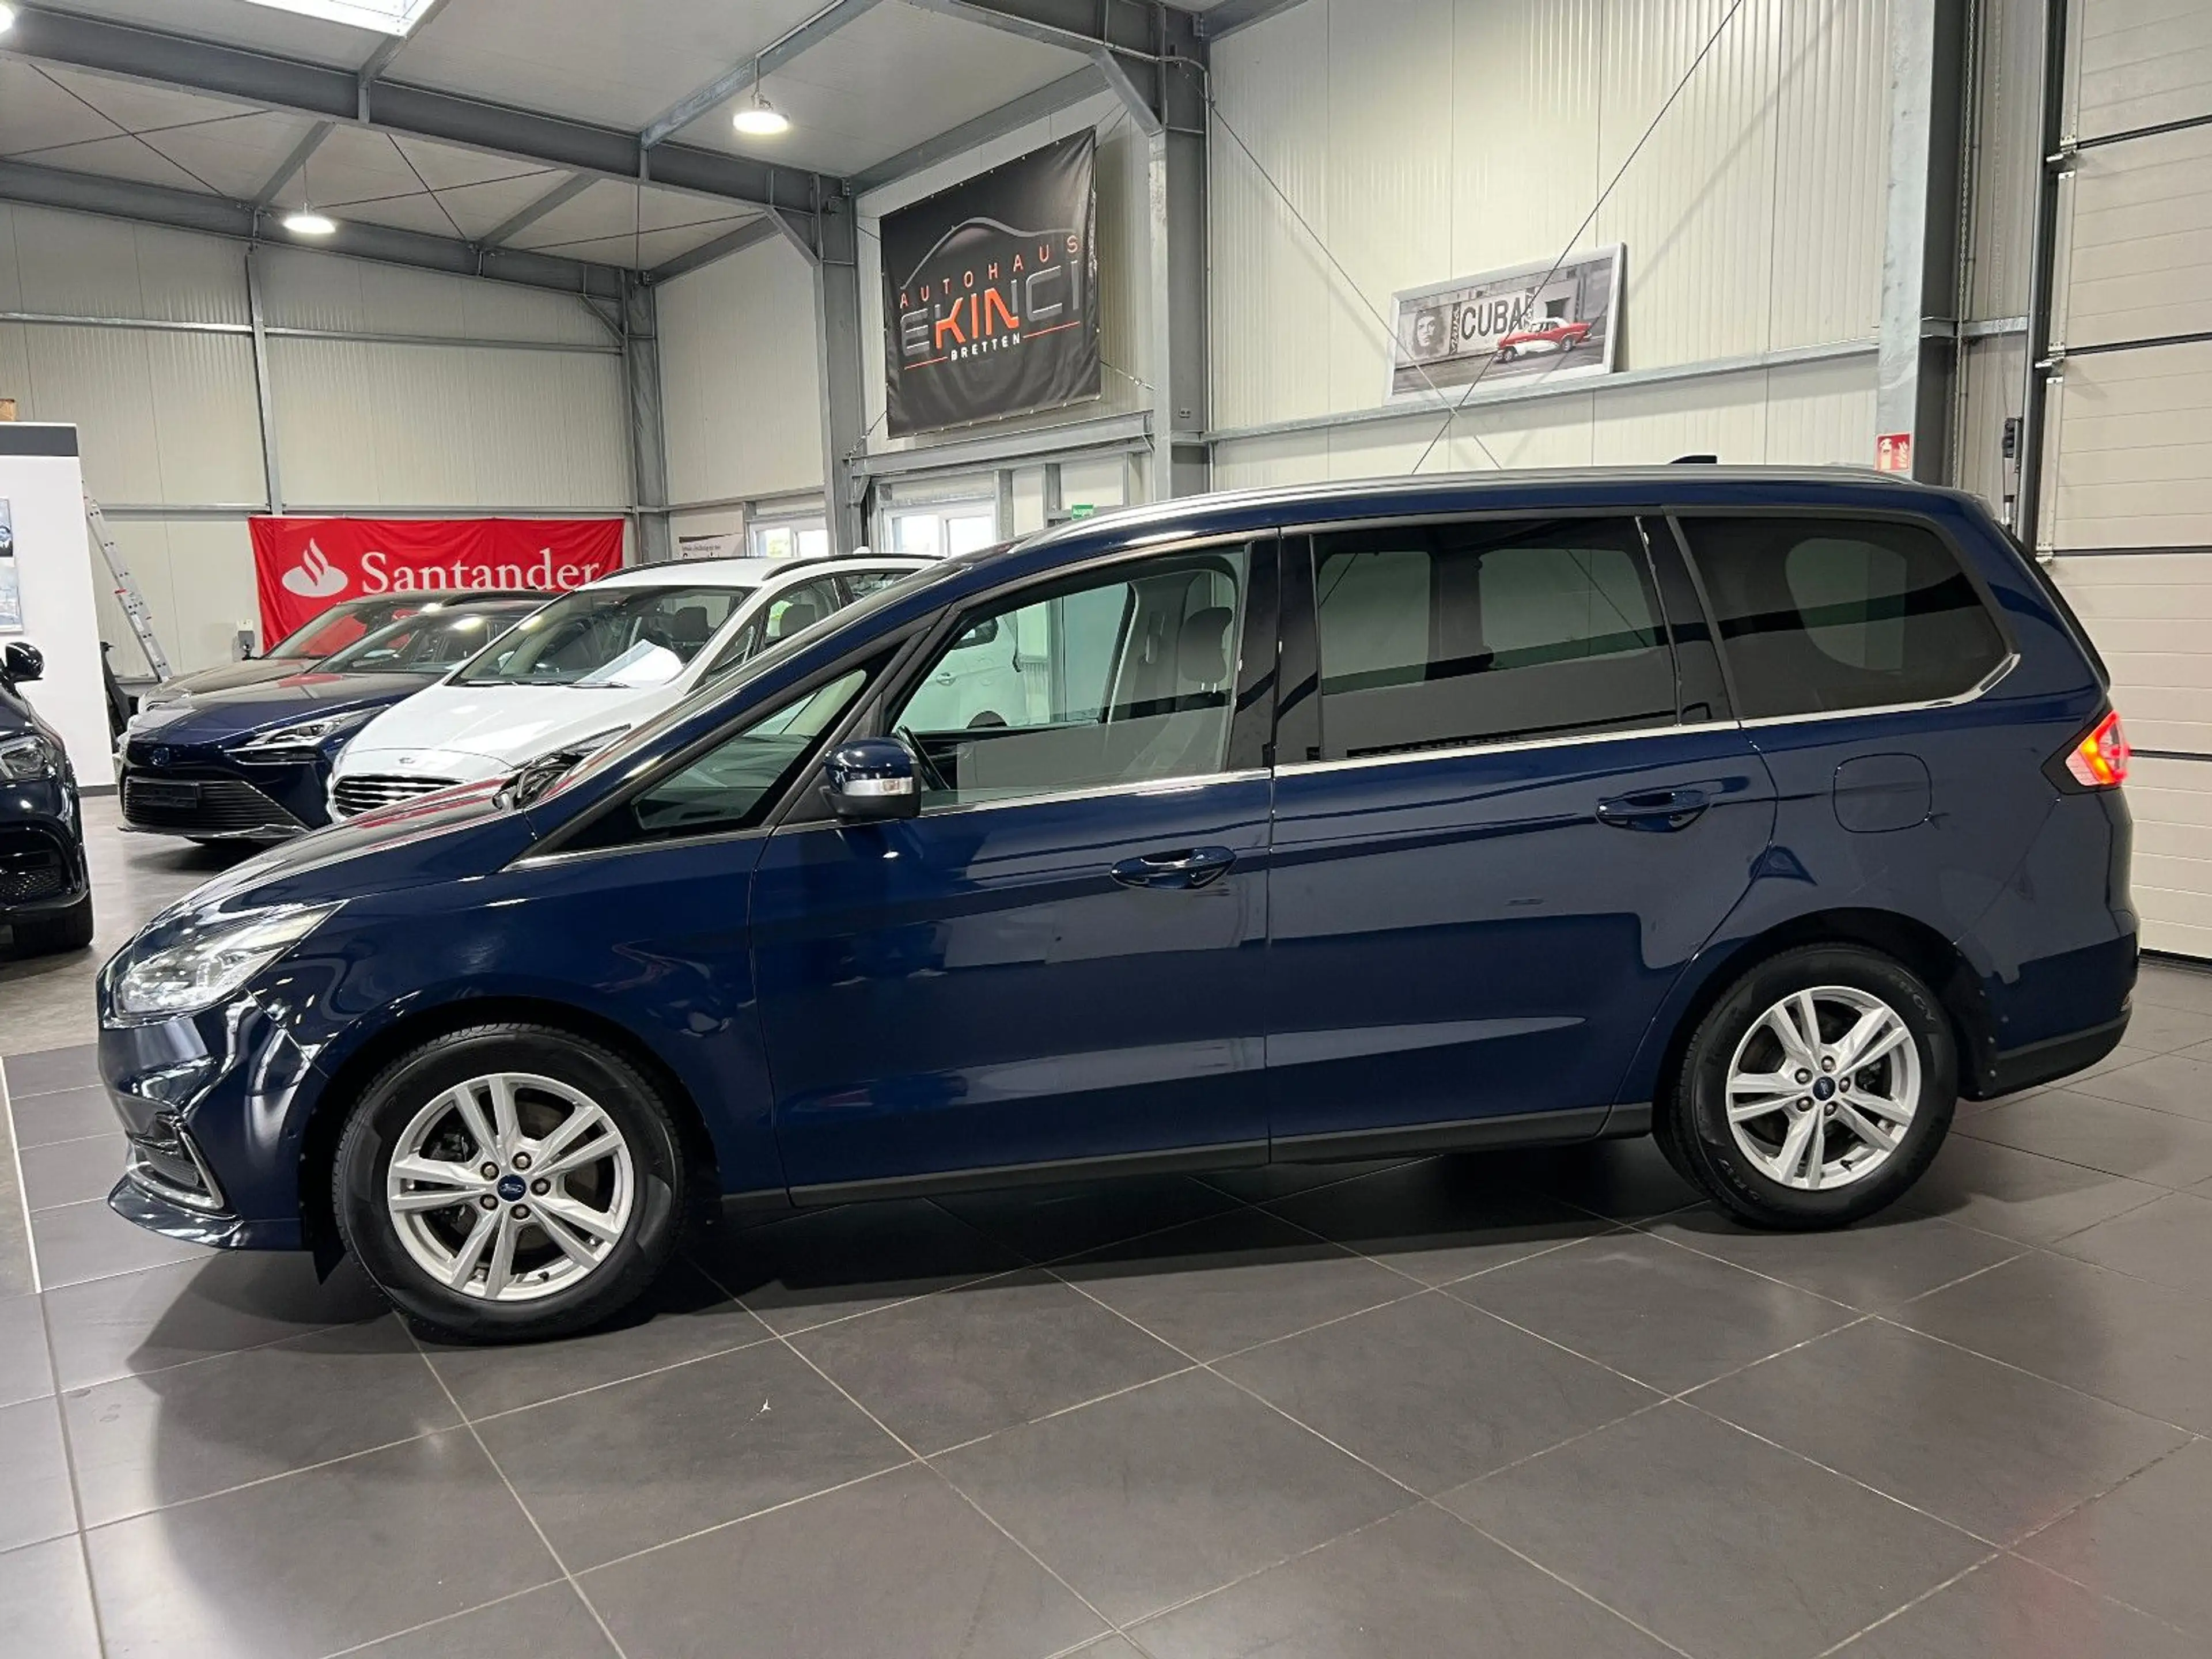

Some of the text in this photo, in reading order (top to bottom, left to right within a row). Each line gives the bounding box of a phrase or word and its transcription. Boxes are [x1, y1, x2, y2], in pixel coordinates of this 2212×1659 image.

[900, 234, 1078, 309] AUTOHAUS
[900, 260, 1080, 357] EKINCI
[1461, 297, 1523, 341] CUBA
[950, 332, 1021, 362] BRETTEN
[361, 547, 600, 593] Santander
